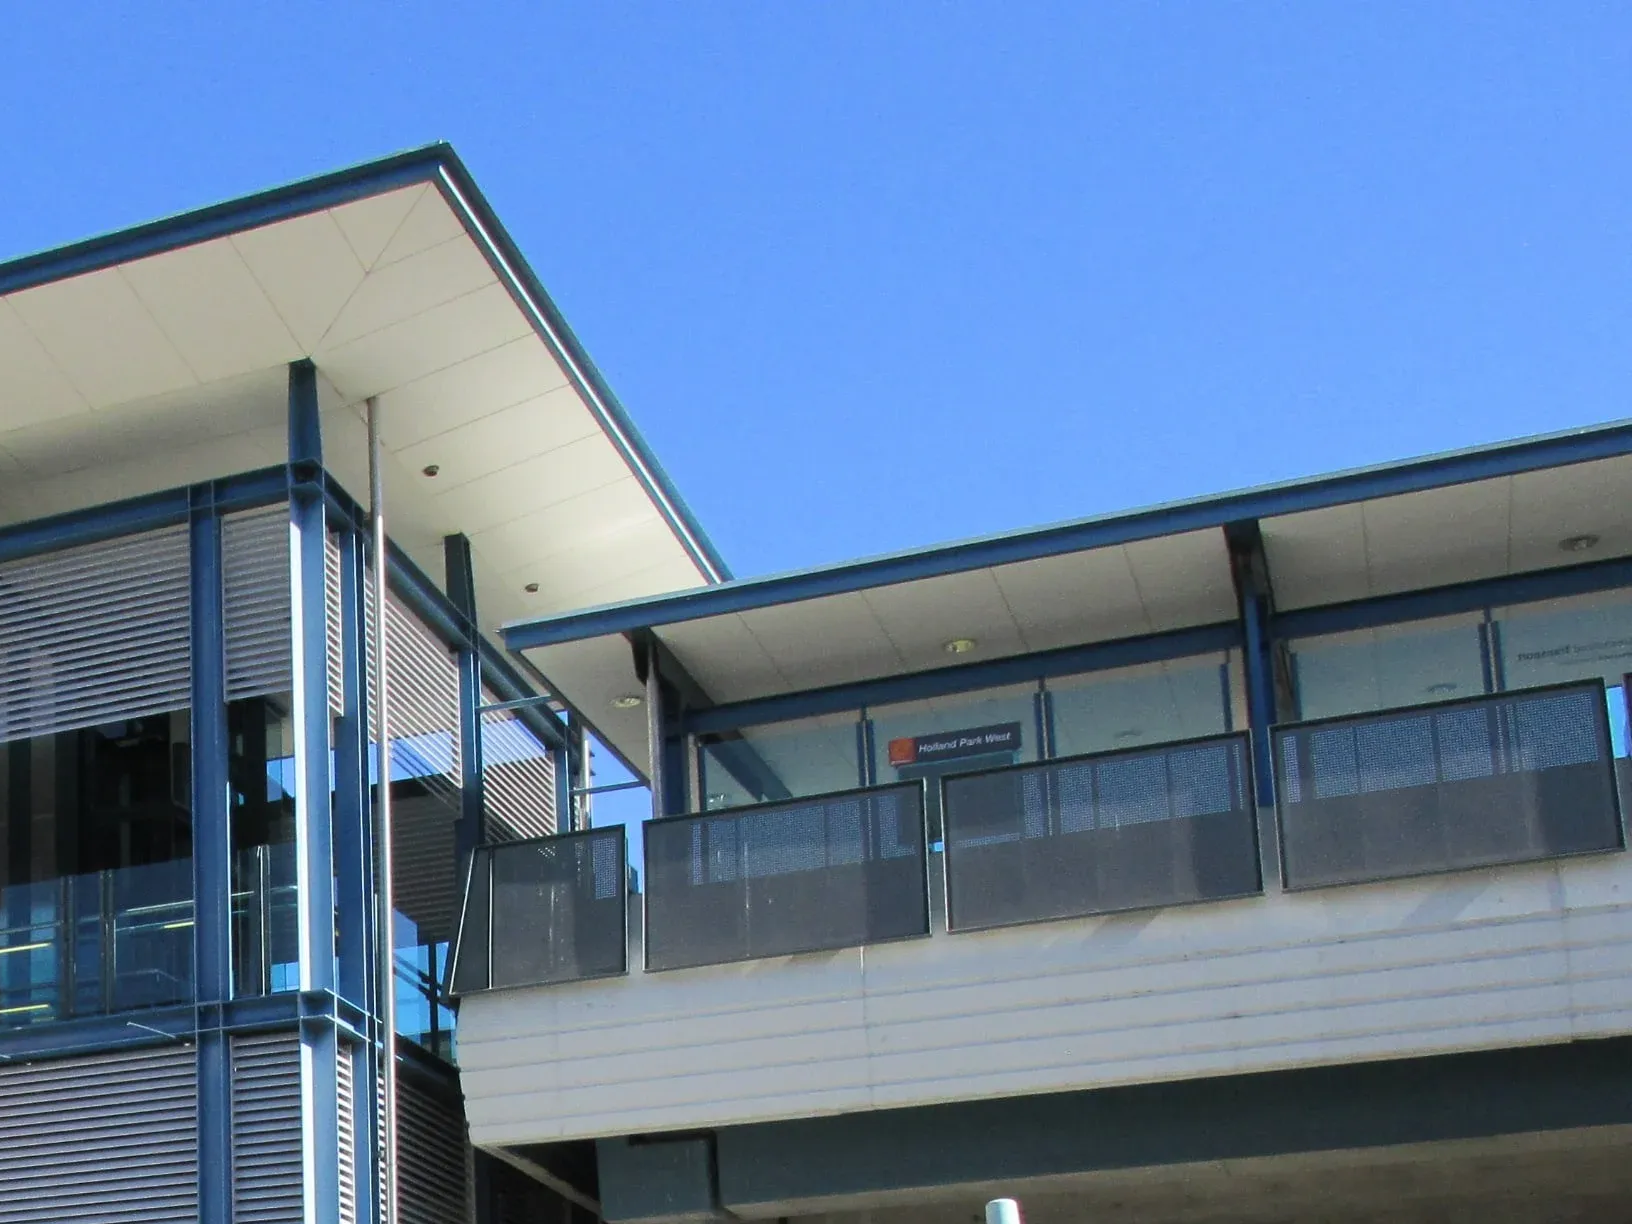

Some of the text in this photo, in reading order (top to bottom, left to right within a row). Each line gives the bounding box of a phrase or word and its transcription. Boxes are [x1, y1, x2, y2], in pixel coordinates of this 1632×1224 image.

[918, 731, 1013, 753] Holland Park West
